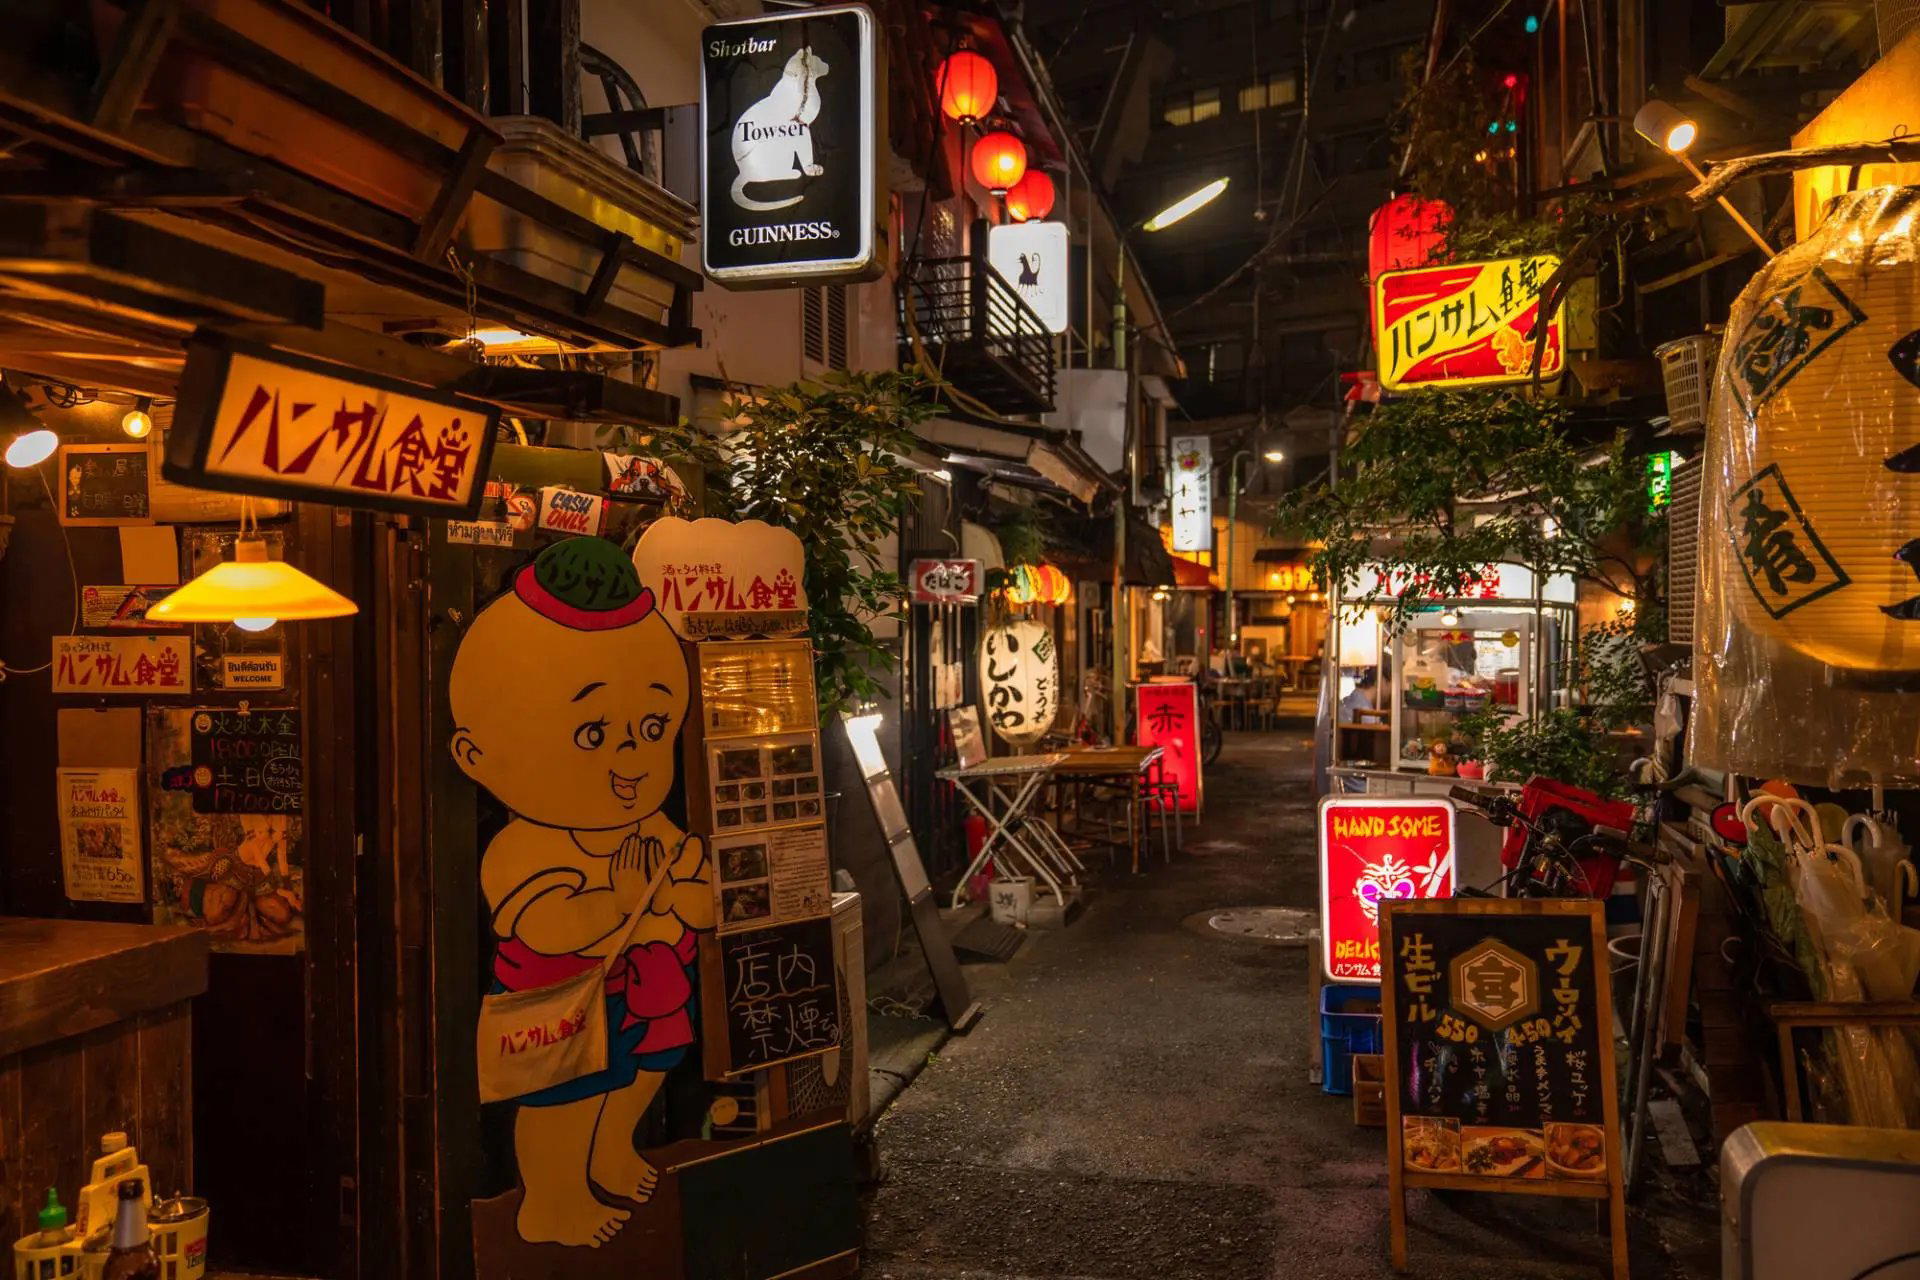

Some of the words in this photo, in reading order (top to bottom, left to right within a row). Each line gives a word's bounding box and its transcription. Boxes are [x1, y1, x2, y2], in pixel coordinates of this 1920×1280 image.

[709, 37, 777, 58] Shotbar
[737, 118, 809, 144] Towser
[219, 384, 472, 501] ハンサム食堂
[550, 490, 594, 515] CASH
[661, 567, 798, 611] ハンサム食堂
[57, 646, 183, 687] ハンサム食堂
[232, 674, 273, 683] WELCOME
[985, 631, 1023, 729] いしかわ
[1400, 932, 1442, 1023] 生ビール
[1435, 1012, 1479, 1044] 550
[1507, 1017, 1553, 1048] 450
